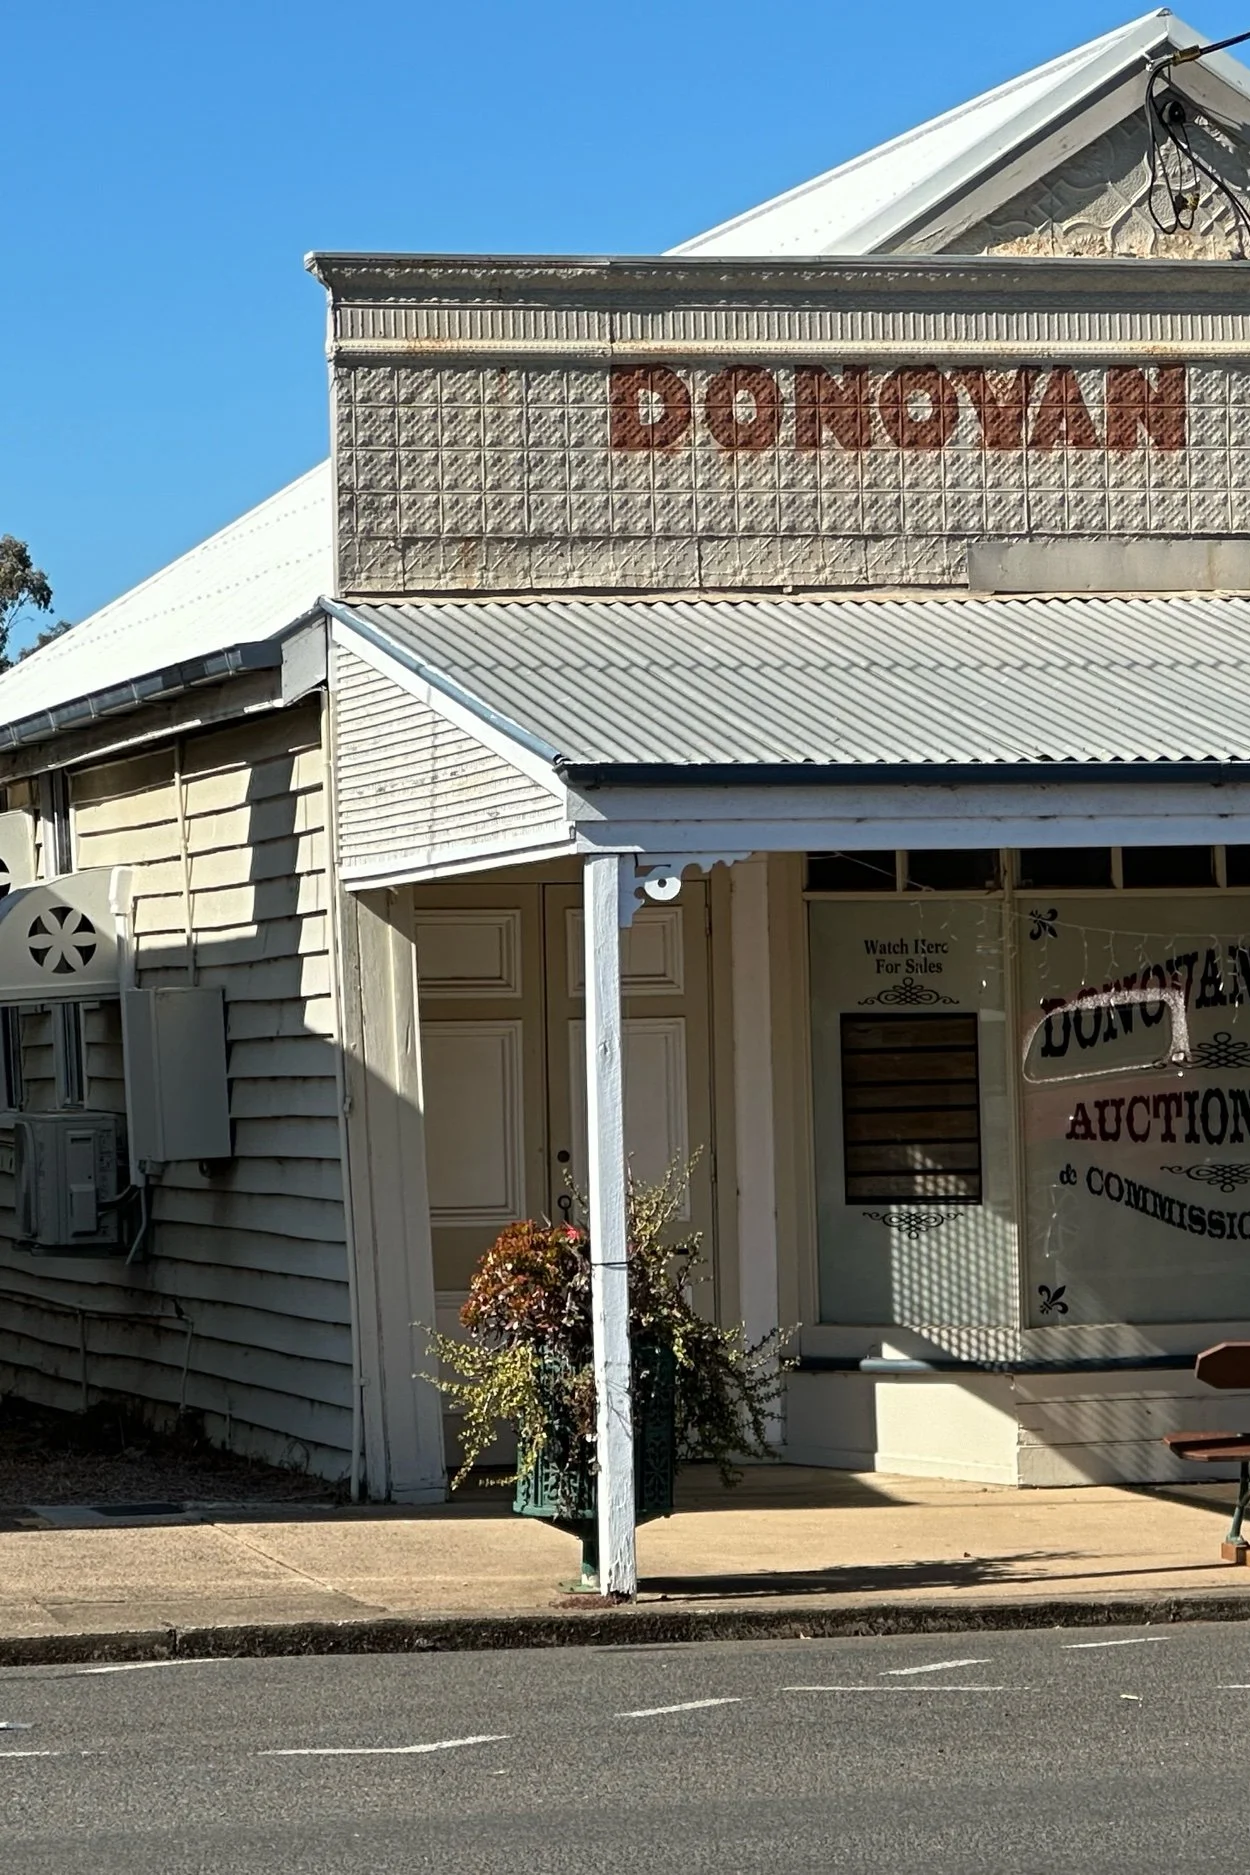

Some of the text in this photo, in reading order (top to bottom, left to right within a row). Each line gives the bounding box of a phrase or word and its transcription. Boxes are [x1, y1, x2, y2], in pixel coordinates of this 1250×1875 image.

[610, 364, 1187, 451] DONOVAN
[864, 938, 949, 954] Watch Here
[876, 957, 943, 974] For Sales
[1059, 1163, 1077, 1185] &
